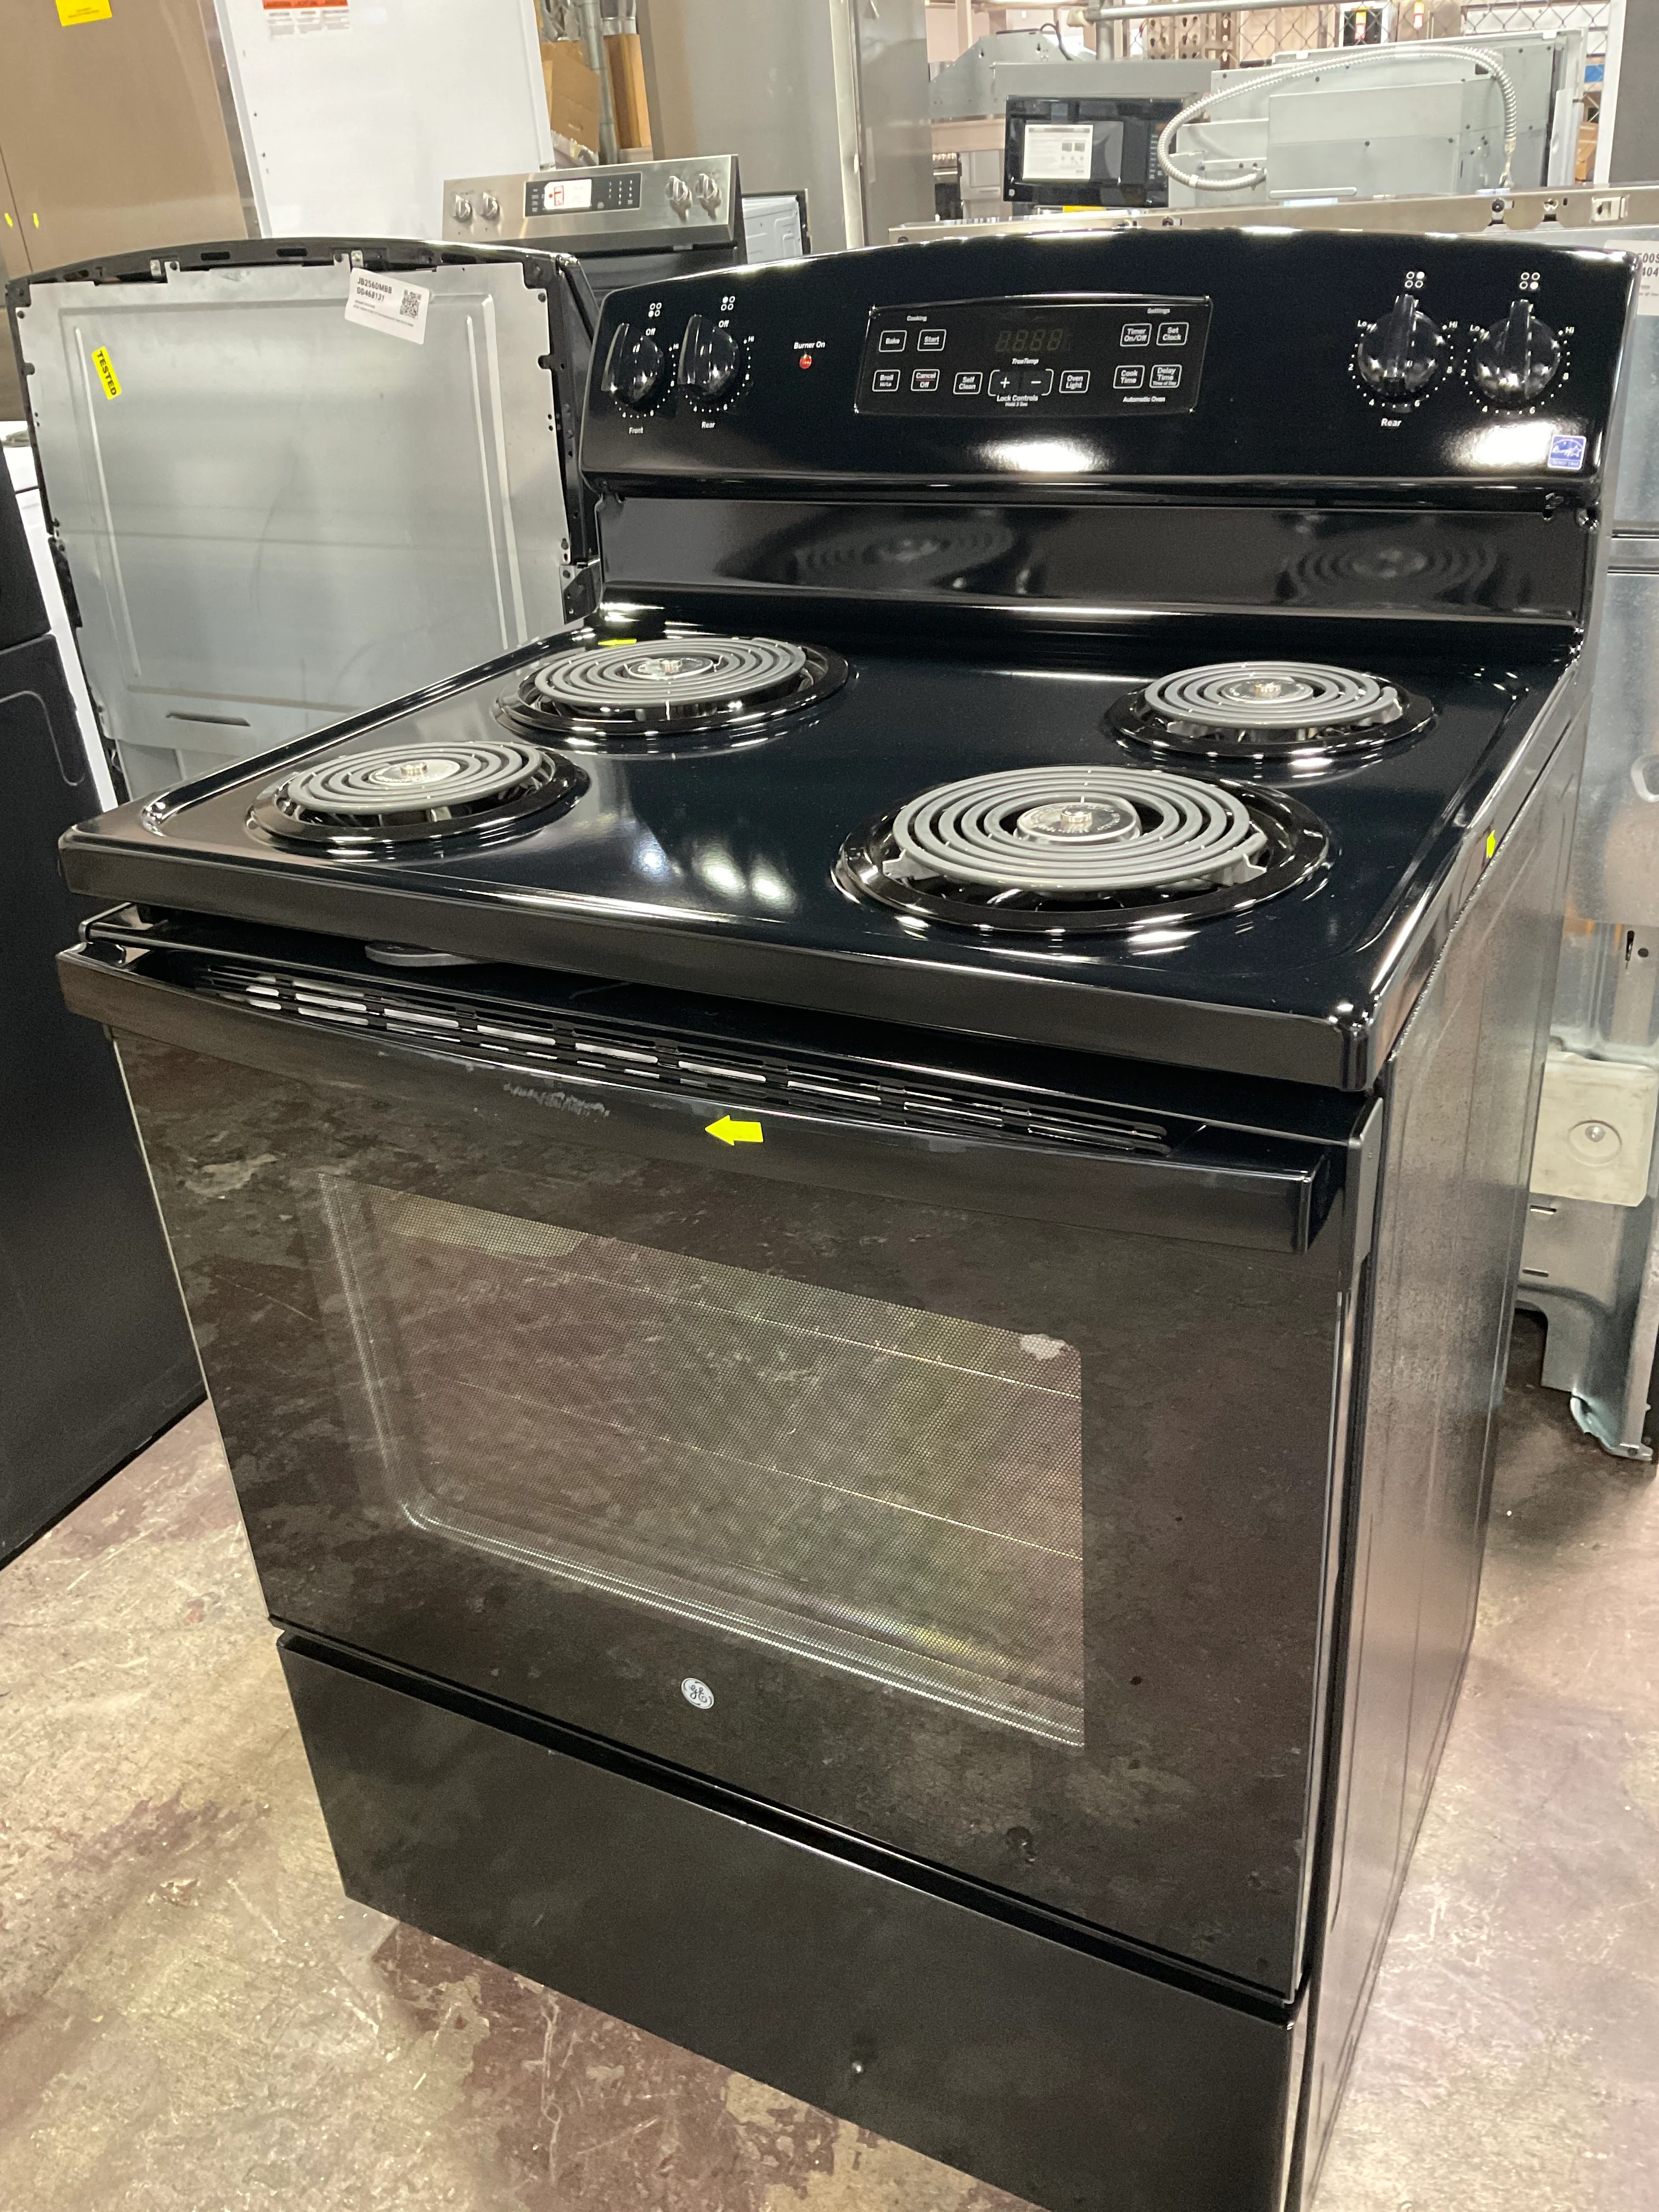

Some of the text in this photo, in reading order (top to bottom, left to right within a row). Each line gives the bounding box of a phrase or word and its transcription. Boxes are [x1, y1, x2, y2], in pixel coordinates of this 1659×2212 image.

[718, 320, 730, 328] Off
[97, 350, 117, 396] TESTED
[1381, 418, 1402, 427] Rear
